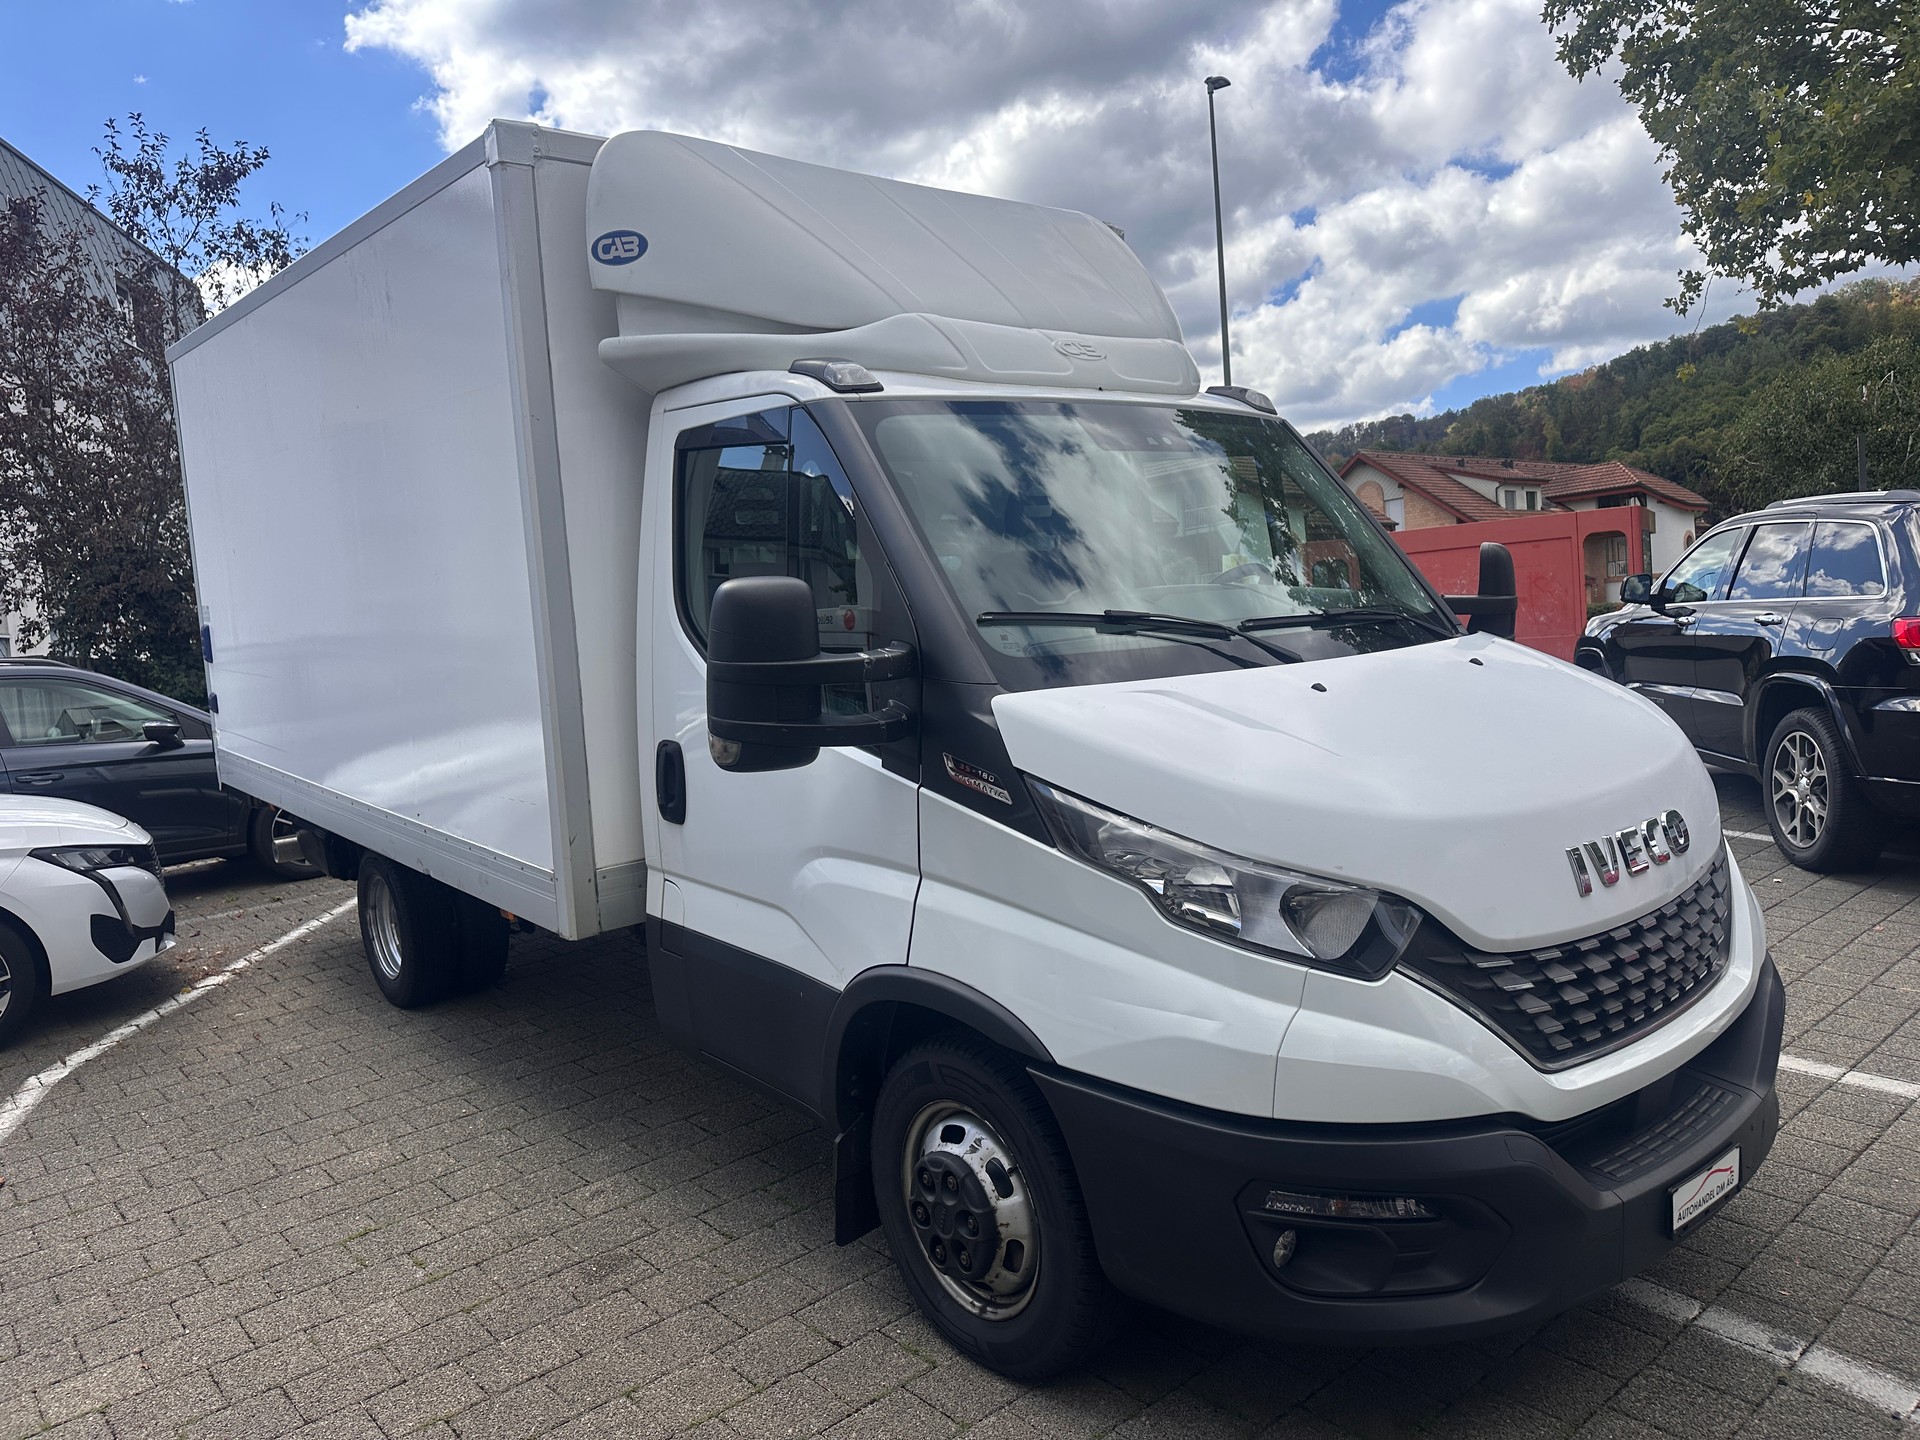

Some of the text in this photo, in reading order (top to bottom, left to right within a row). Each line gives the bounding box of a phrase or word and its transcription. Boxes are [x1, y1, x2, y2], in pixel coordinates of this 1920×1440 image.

[598, 236, 639, 260] CAB
[1565, 809, 1690, 898] IVECO
[1677, 1174, 1735, 1223] AUTOHANDEL DM AG
